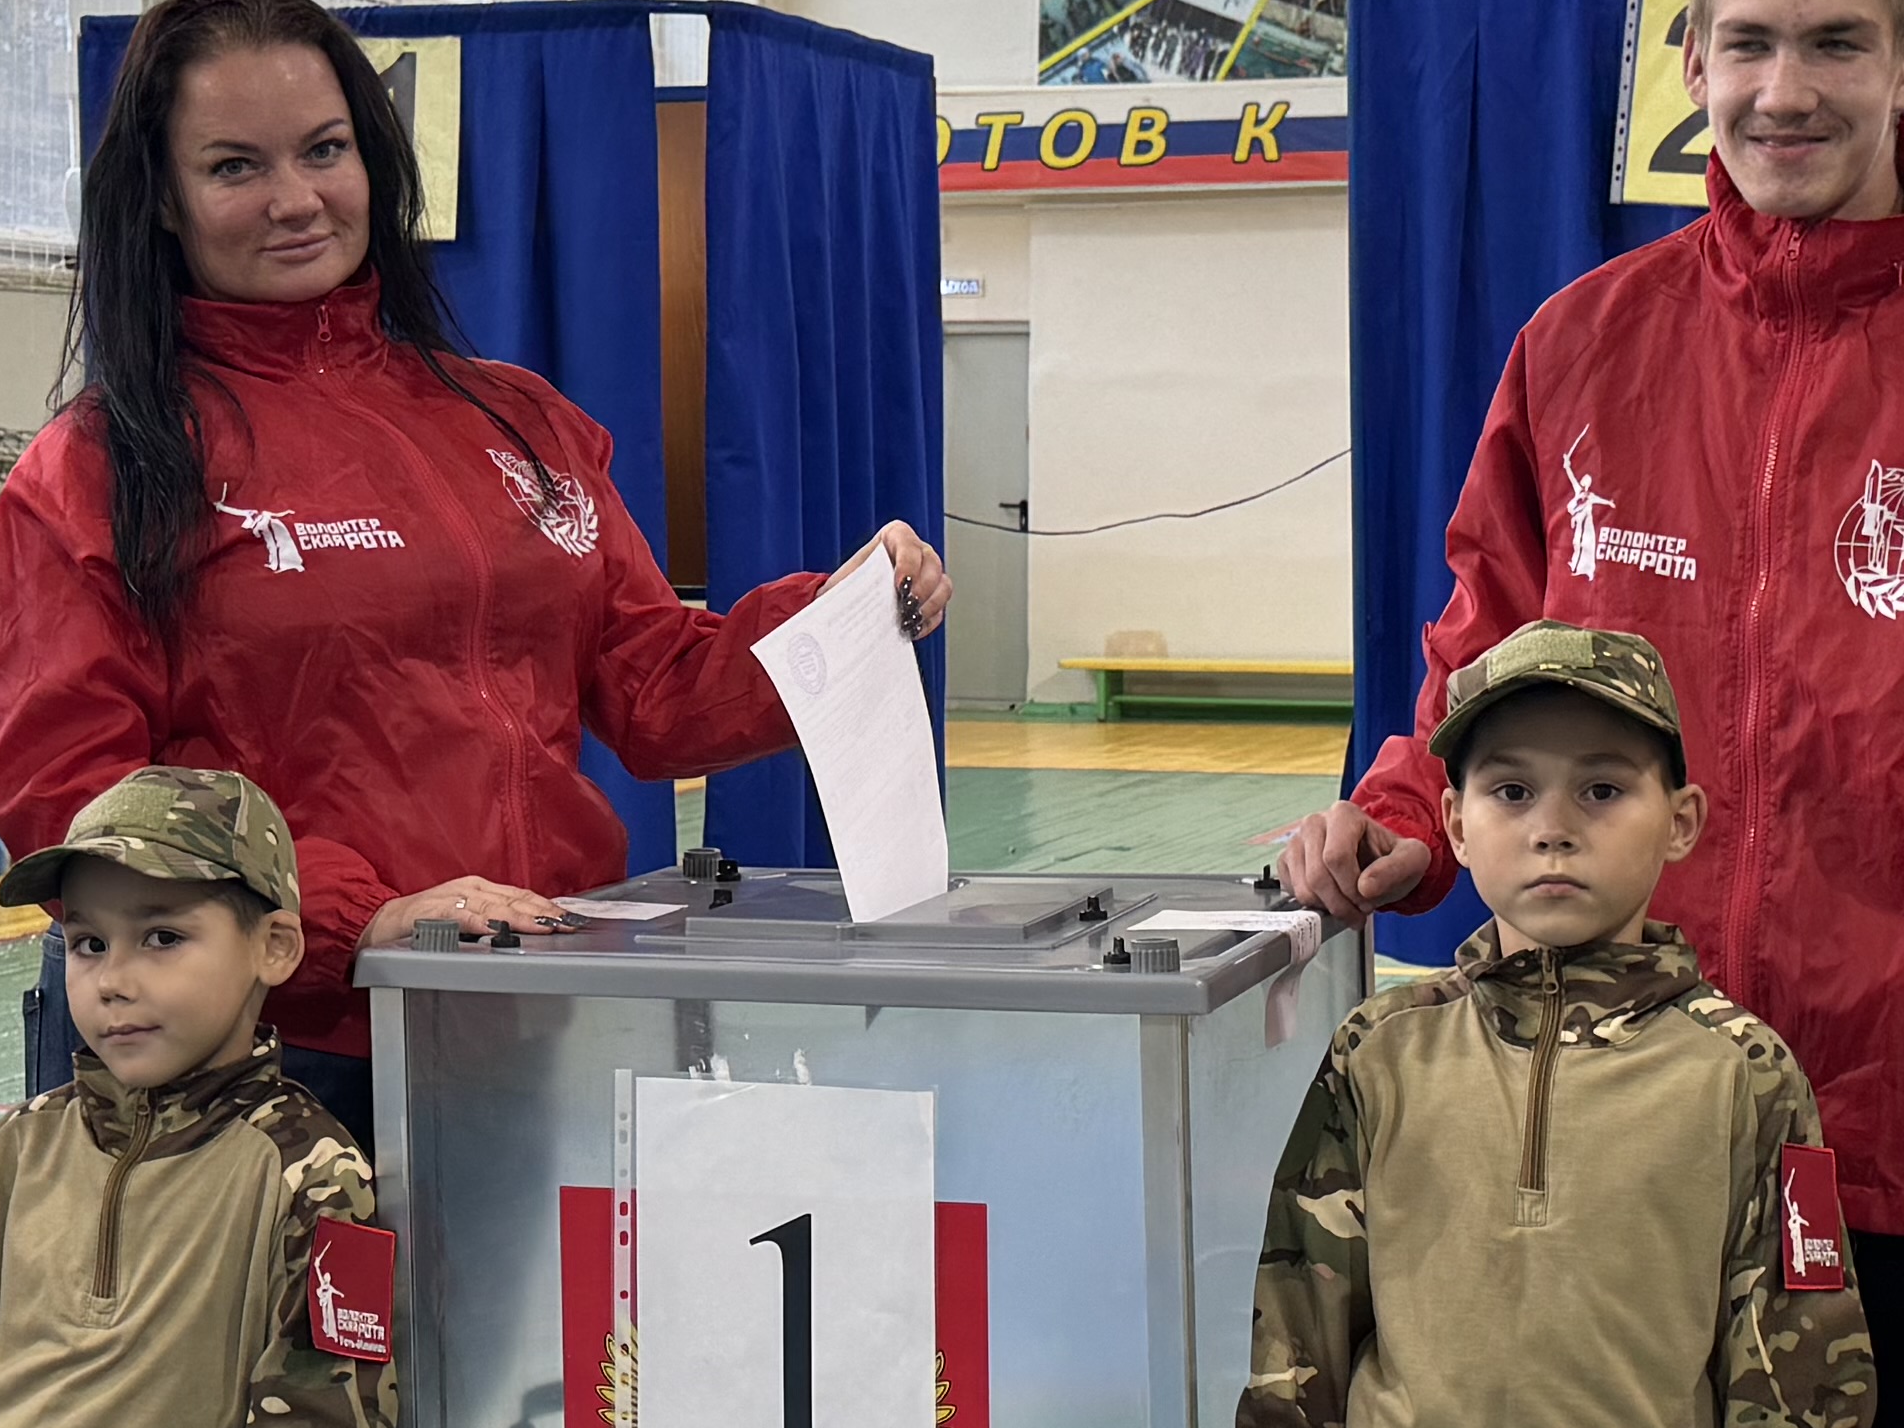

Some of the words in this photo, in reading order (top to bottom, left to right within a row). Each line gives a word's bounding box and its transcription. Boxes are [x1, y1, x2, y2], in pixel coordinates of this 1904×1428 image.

[936, 108, 1169, 171] ТОВ
[1232, 101, 1290, 164] К
[294, 518, 381, 536] ВОЛОНТЕР
[1598, 526, 1687, 555] ВОЛОНТЕР
